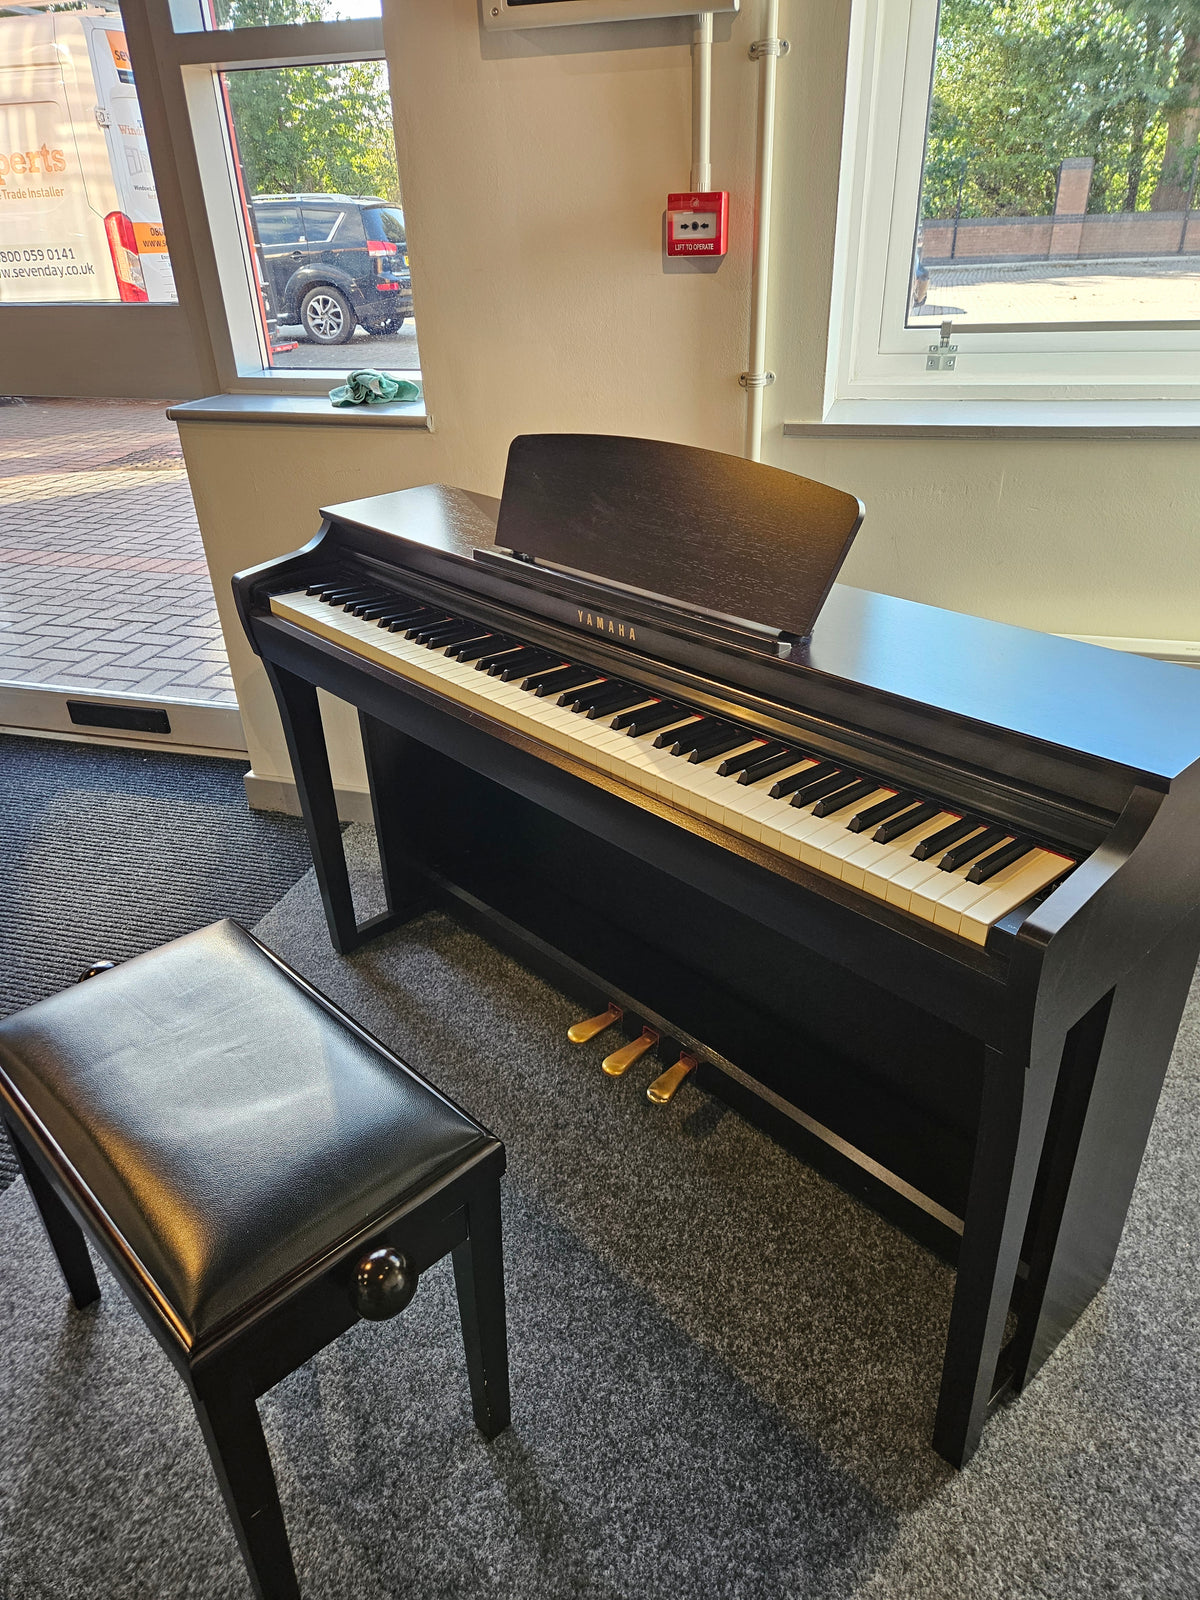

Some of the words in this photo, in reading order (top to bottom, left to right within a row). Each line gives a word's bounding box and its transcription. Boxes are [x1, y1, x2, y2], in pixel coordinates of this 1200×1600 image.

[1, 188, 27, 200] Trade
[27, 186, 65, 198] Installer
[686, 243, 693, 251] TO
[0, 250, 21, 263] 800
[23, 249, 45, 261] 059
[46, 248, 76, 260] 0141
[0, 262, 95, 278] w.sevenday.co.uk
[577, 609, 636, 641] YAMAHA
